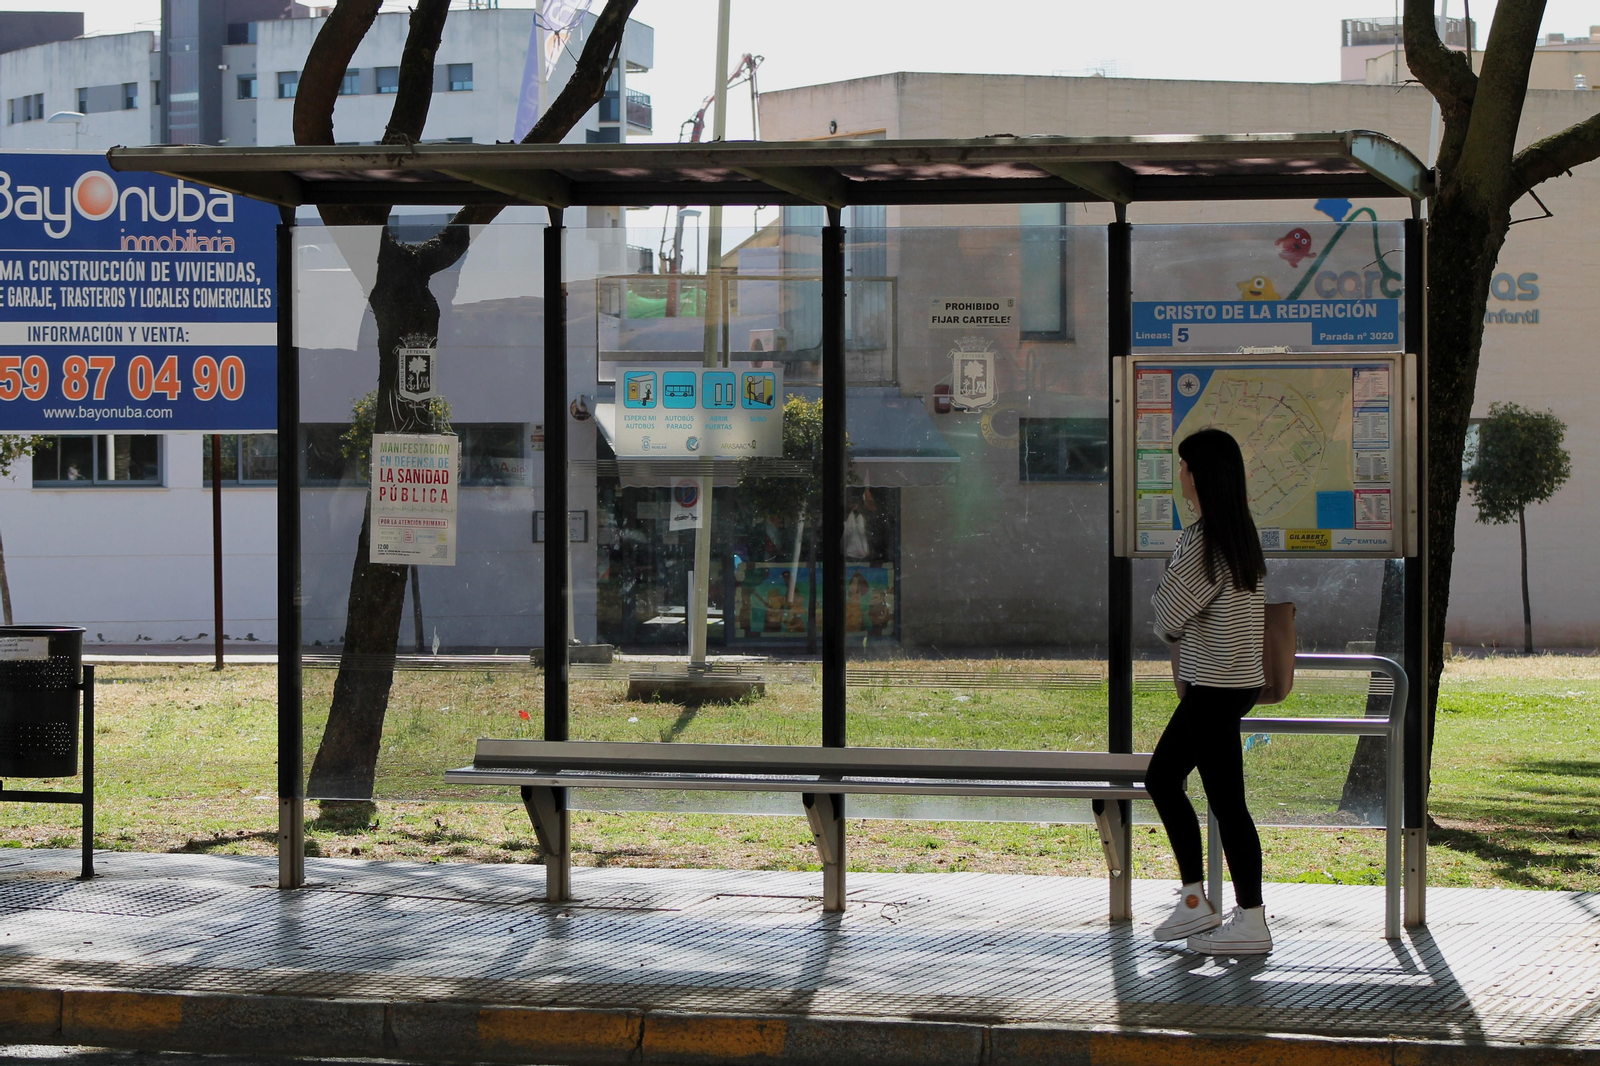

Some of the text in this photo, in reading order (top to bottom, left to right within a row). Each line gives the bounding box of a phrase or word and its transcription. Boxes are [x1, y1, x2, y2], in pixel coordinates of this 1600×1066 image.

[121, 228, 235, 252] inmobiliaria
[29, 258, 146, 282] CONSTRUCCIÓN
[151, 261, 170, 282] DE
[175, 262, 261, 285] VIVIENDAS,
[8, 286, 56, 310] GARAJE,
[60, 286, 125, 308] TRASTEROS
[129, 288, 136, 308] Y
[140, 288, 189, 308] LOCALES
[193, 288, 271, 308] COMERCIALES
[945, 302, 999, 310] PROHIBIDO
[1154, 300, 1377, 320] CRISTO DE LA REDENCIÓN
[28, 324, 189, 342] INFORMACIÓN Y VENTA:
[1136, 331, 1171, 340] Líneas:
[1177, 328, 1189, 342] 5
[1320, 332, 1355, 341] Parada
[62, 355, 115, 401] 87
[128, 355, 181, 401] 04
[193, 355, 245, 401] 90
[43, 406, 172, 421] www.bayonuba.com
[380, 442, 450, 454] MANIFESTACIÓN
[380, 456, 449, 468] EN DEFENSA DE
[380, 468, 449, 484] LA SANIDAD
[380, 484, 448, 503] PÚBLICA
